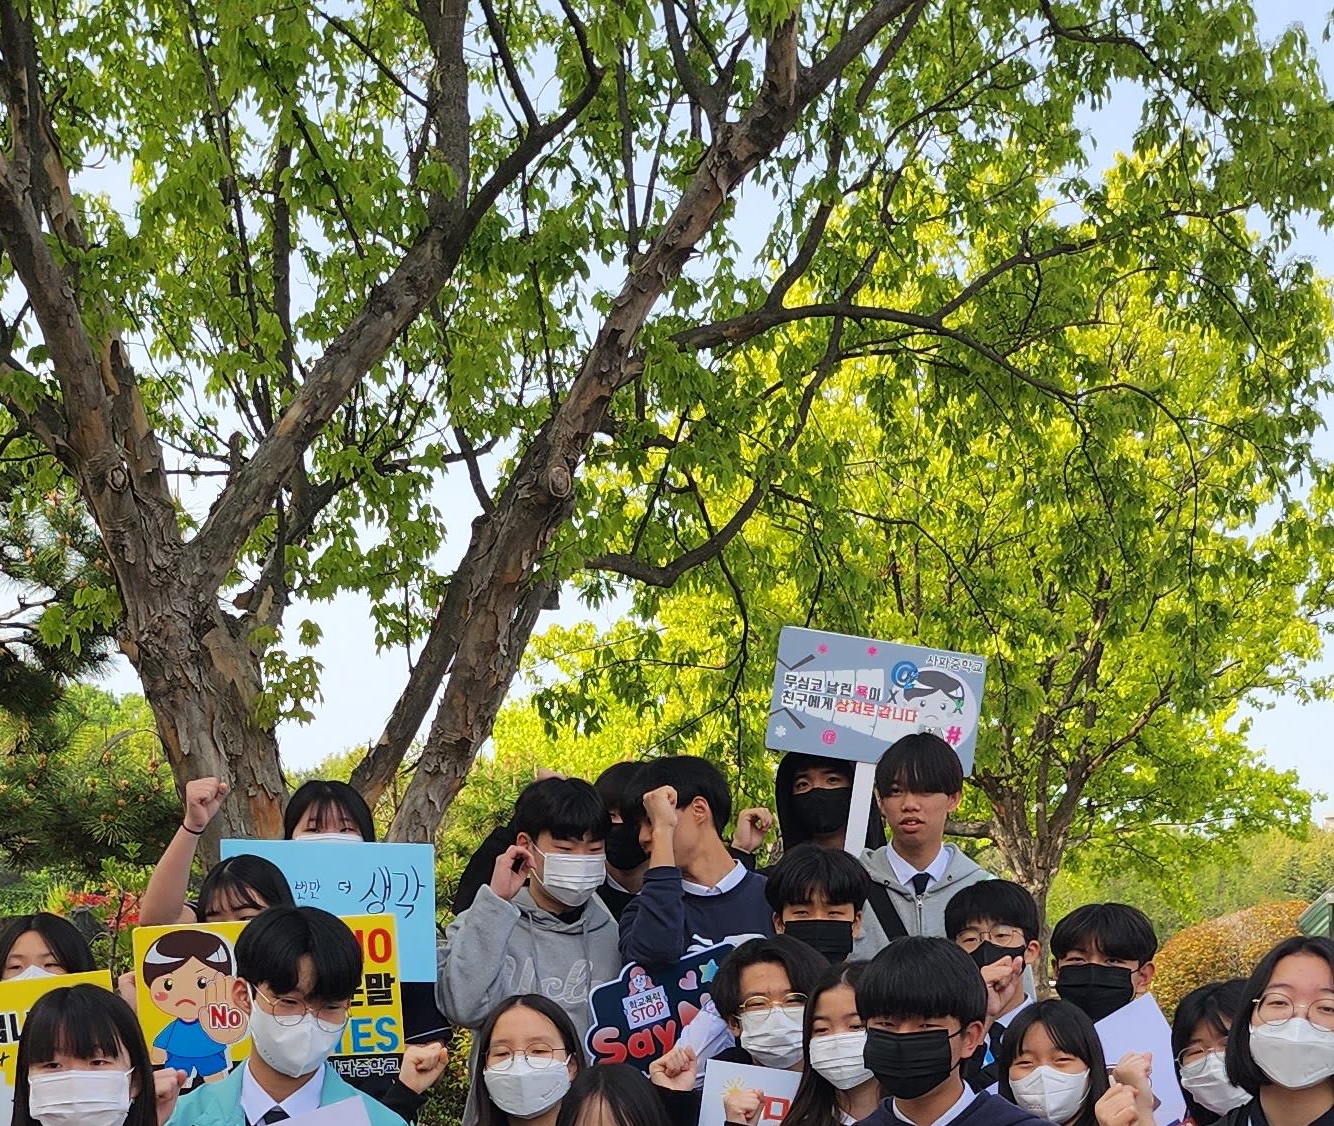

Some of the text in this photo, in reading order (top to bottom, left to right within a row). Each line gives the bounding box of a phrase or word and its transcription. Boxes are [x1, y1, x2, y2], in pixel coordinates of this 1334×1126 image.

[927, 654, 984, 673] 사파중학교
[785, 674, 823, 692] 무심코
[827, 681, 853, 697] 날린
[782, 690, 834, 711] 친구에게
[836, 699, 876, 717] 상처로
[337, 880, 352, 895] 더
[359, 865, 427, 919] 생각
[356, 928, 393, 964] O
[210, 1005, 243, 1029] No
[631, 1001, 665, 1024] STOP
[592, 1017, 677, 1065] Say
